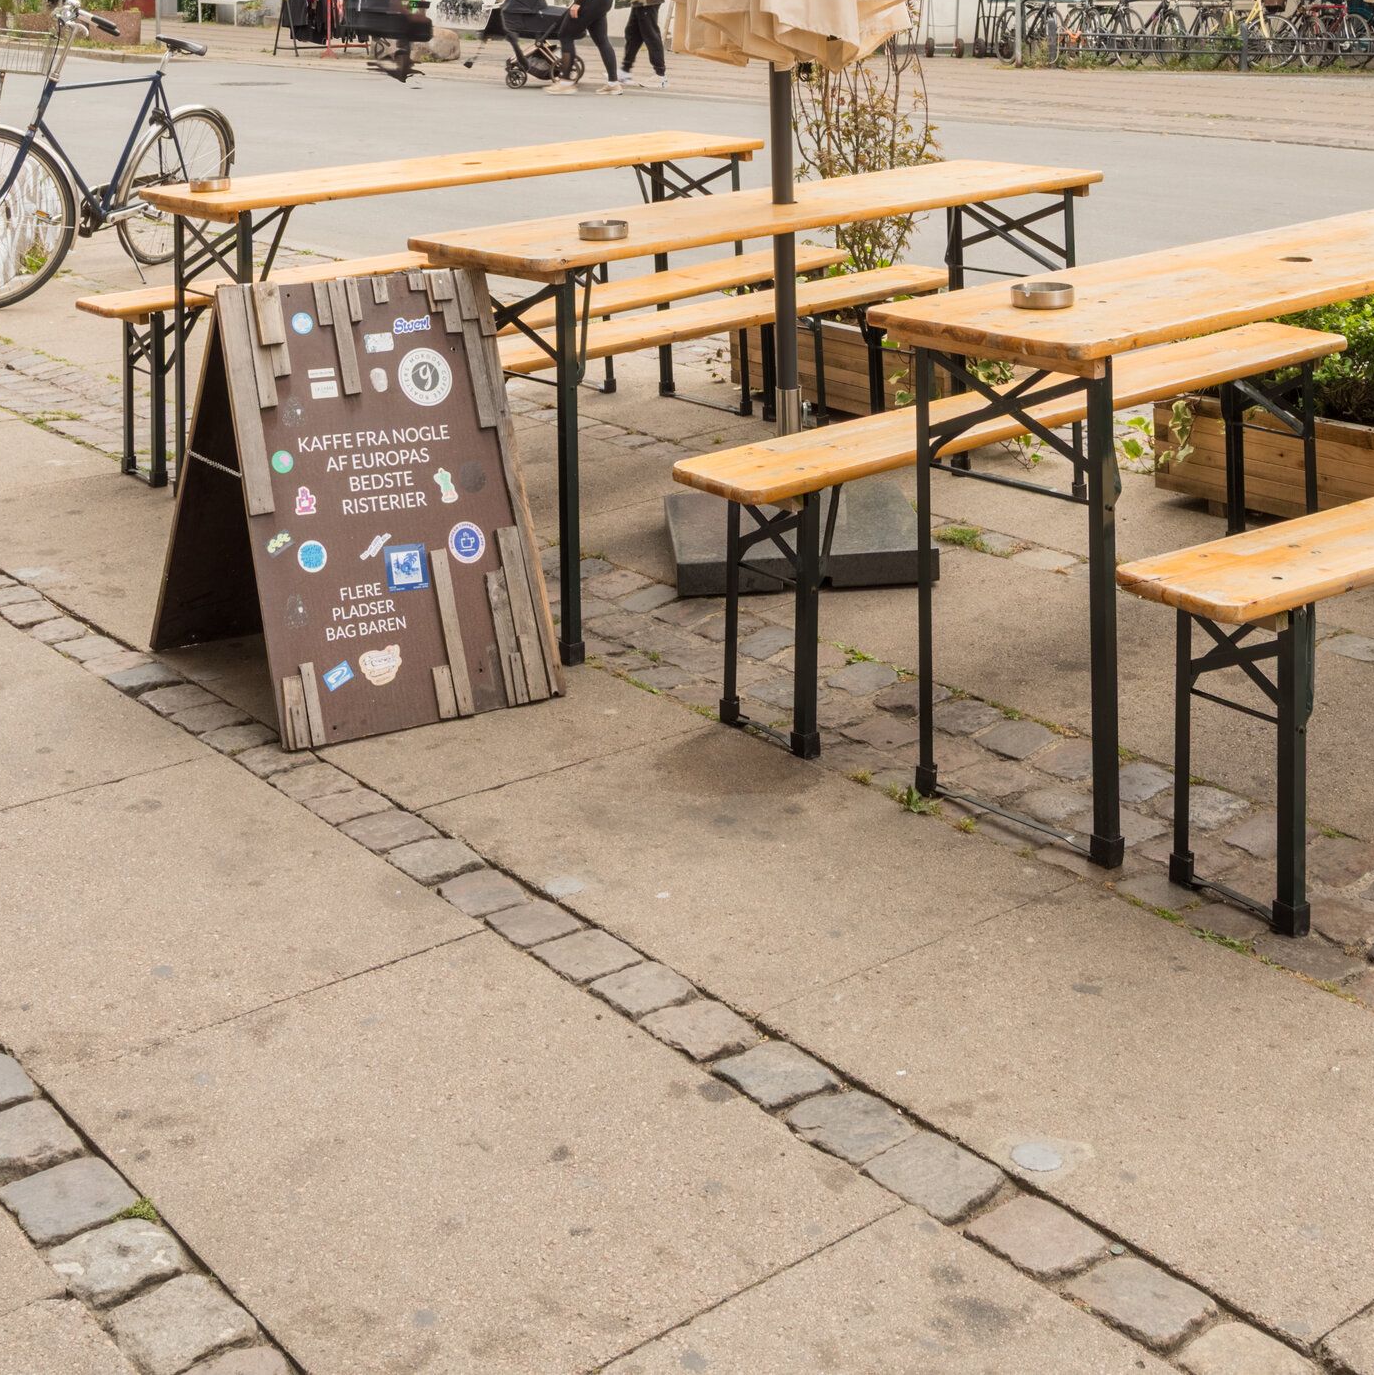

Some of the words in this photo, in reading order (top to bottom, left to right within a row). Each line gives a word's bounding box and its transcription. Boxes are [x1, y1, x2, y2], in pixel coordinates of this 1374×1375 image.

[298, 432, 354, 453] KAFFE
[356, 430, 390, 448] FRA
[392, 424, 451, 444] NOGLE
[326, 455, 348, 472] AF
[351, 447, 430, 470] EUROPAS
[349, 470, 415, 492] BEDSTE
[342, 491, 428, 515] RISTERIER
[339, 582, 383, 601] FLERE
[332, 599, 395, 621] PLADSER
[325, 624, 357, 642] BAG
[358, 616, 407, 637] BAREN
